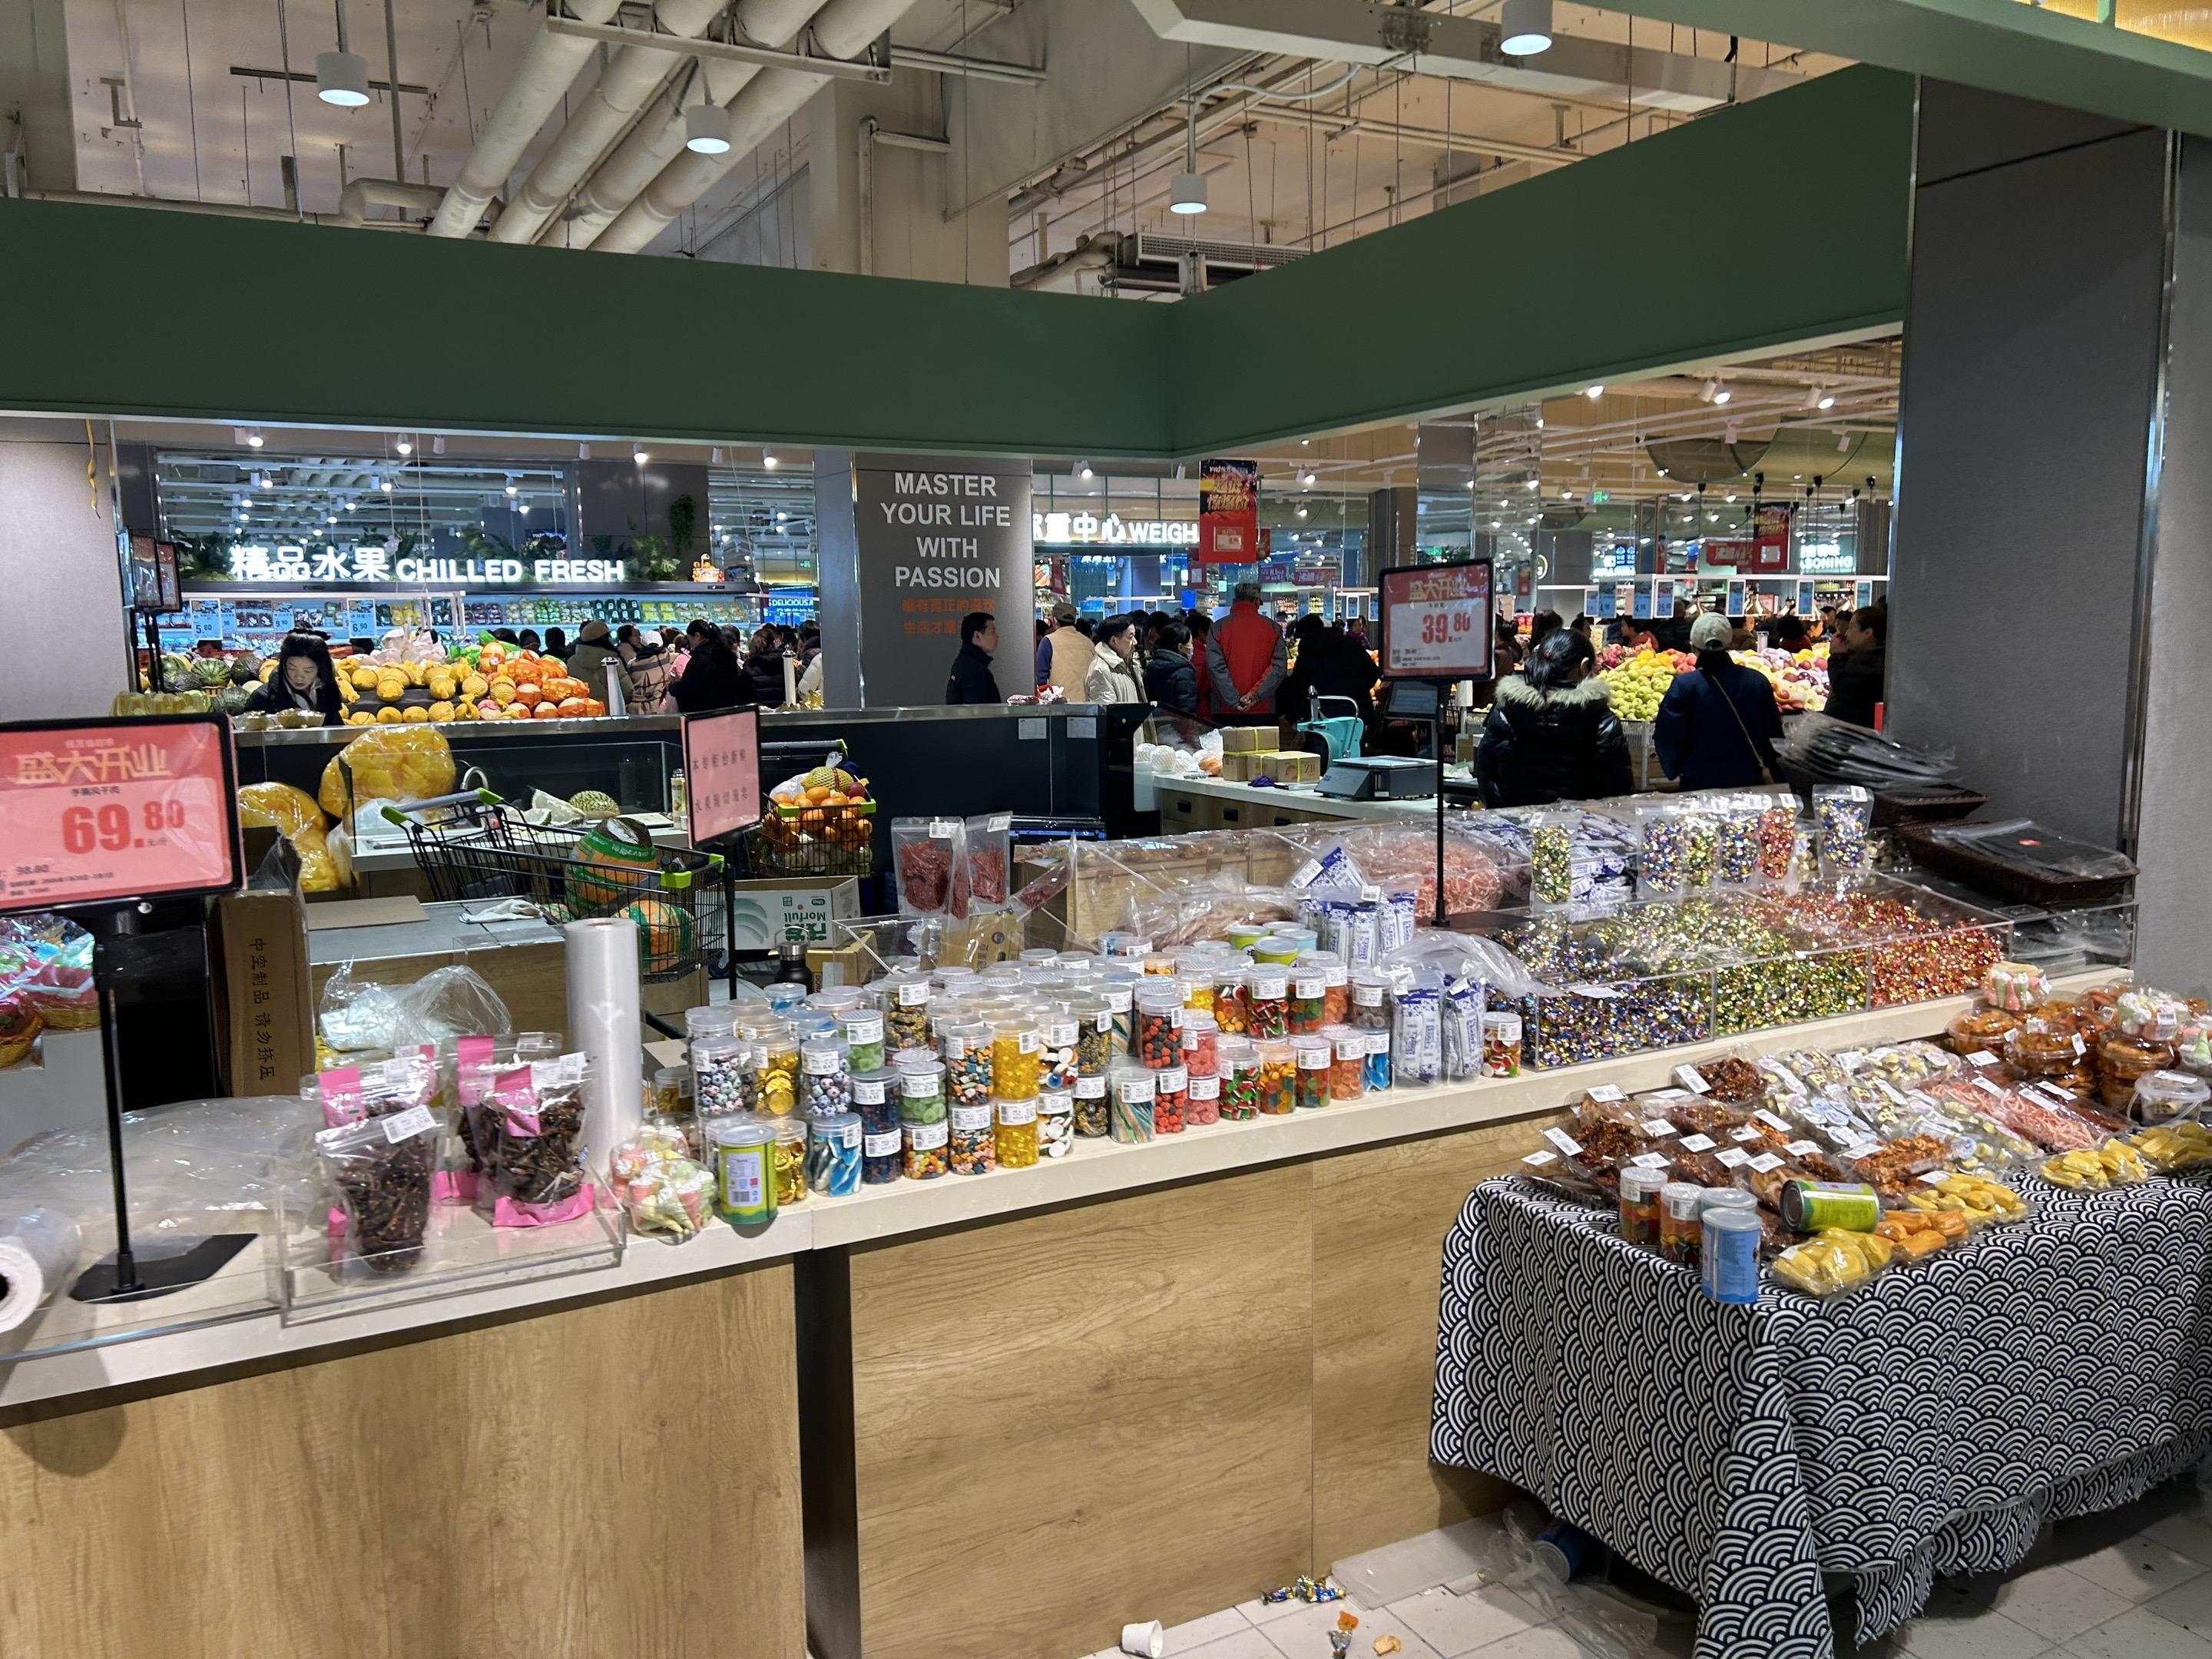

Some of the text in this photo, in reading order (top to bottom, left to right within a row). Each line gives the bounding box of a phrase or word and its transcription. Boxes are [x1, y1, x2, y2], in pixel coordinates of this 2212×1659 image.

[895, 472, 997, 497] MASTER
[880, 502, 1011, 527] YOUR LIFE
[1128, 522, 1200, 544] WEIGH
[916, 537, 978, 558] WITH
[230, 544, 624, 582] 精品水果 CHILLED FRESH
[895, 566, 1000, 588] PASSION
[196, 624, 212, 634] 5.80
[353, 622, 368, 633] 6.90
[15, 743, 173, 785] 盛大开业
[61, 799, 185, 855] 69.80
[784, 912, 826, 923] Morfull
[249, 938, 276, 1081] 中空制品 请勿挤压
